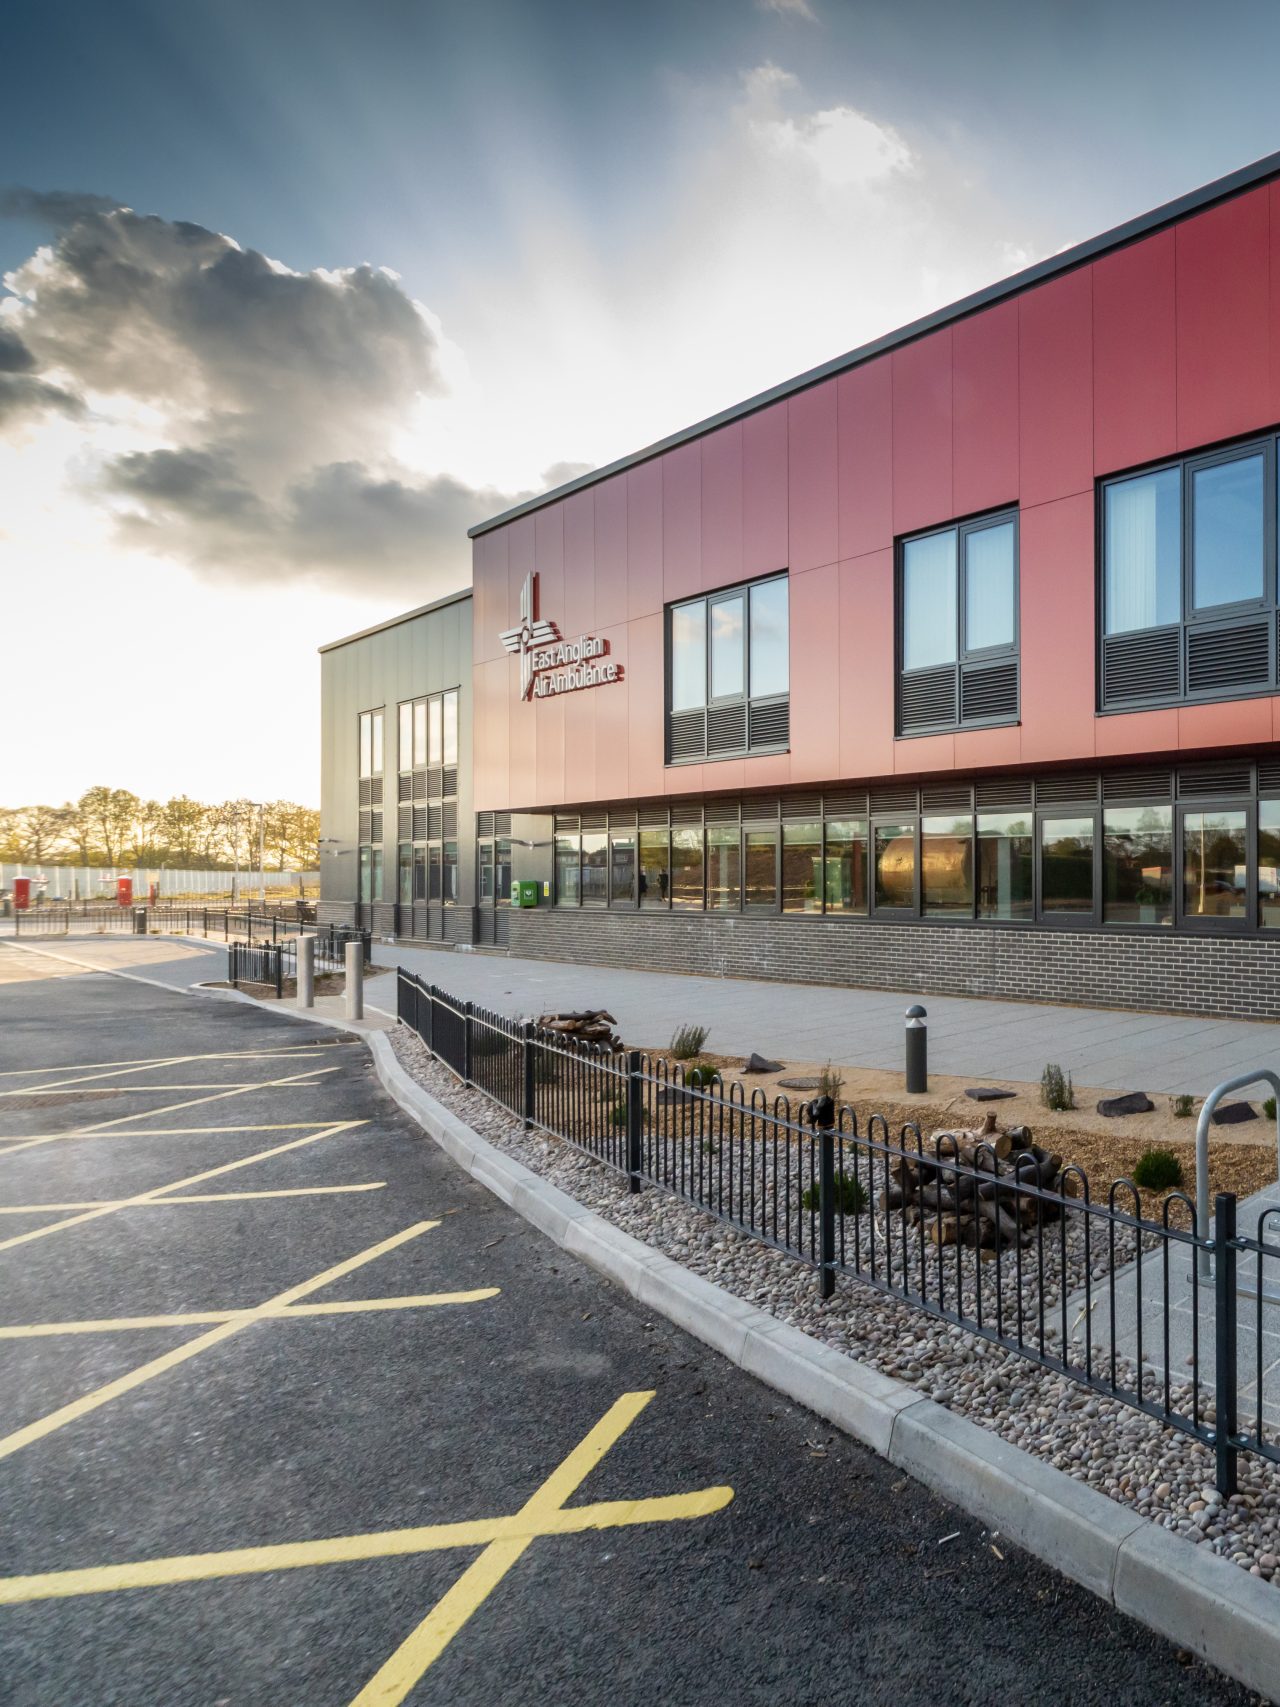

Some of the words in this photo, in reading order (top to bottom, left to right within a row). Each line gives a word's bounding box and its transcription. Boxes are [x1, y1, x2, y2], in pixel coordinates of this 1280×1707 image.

[532, 649, 555, 671] East
[556, 635, 603, 665] Anglian
[533, 676, 549, 697] Air
[549, 662, 616, 693] Ambulance
